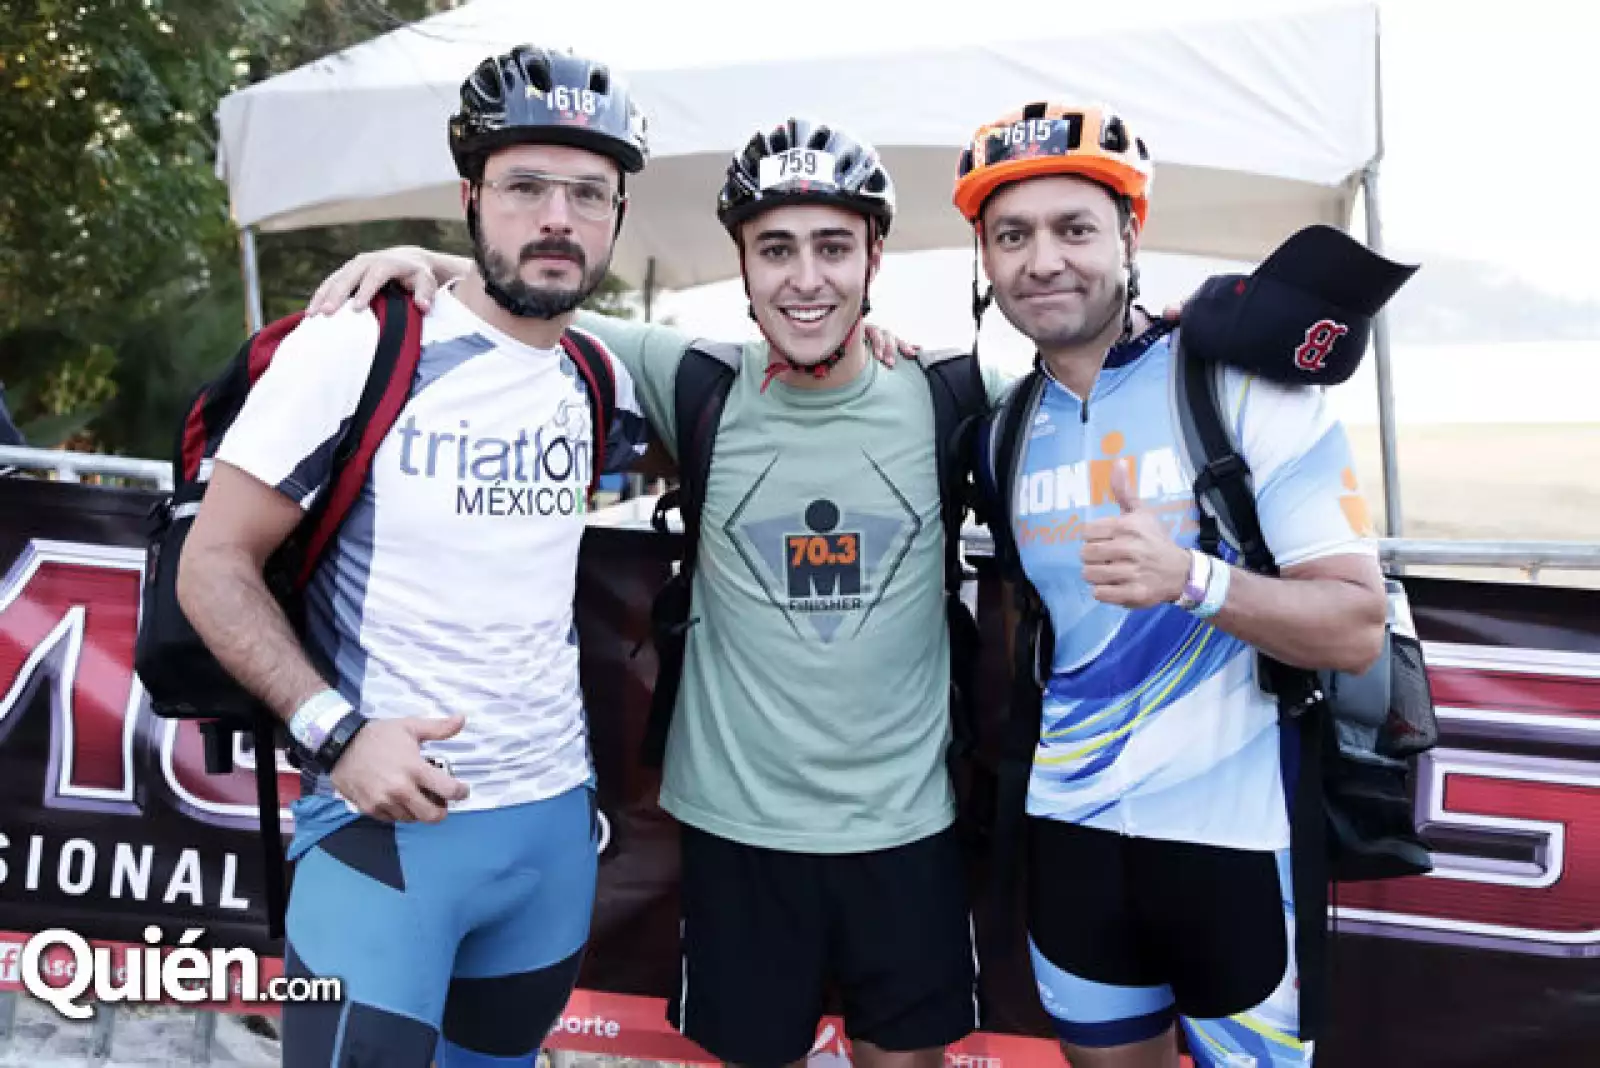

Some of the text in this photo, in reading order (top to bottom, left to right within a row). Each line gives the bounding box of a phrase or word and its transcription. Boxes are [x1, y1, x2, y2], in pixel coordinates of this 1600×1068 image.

[546, 85, 596, 116] 1618
[1001, 118, 1051, 146] 1615
[778, 149, 816, 176] 759
[456, 475, 574, 516] MÉXICO
[788, 535, 857, 567] 70.3
